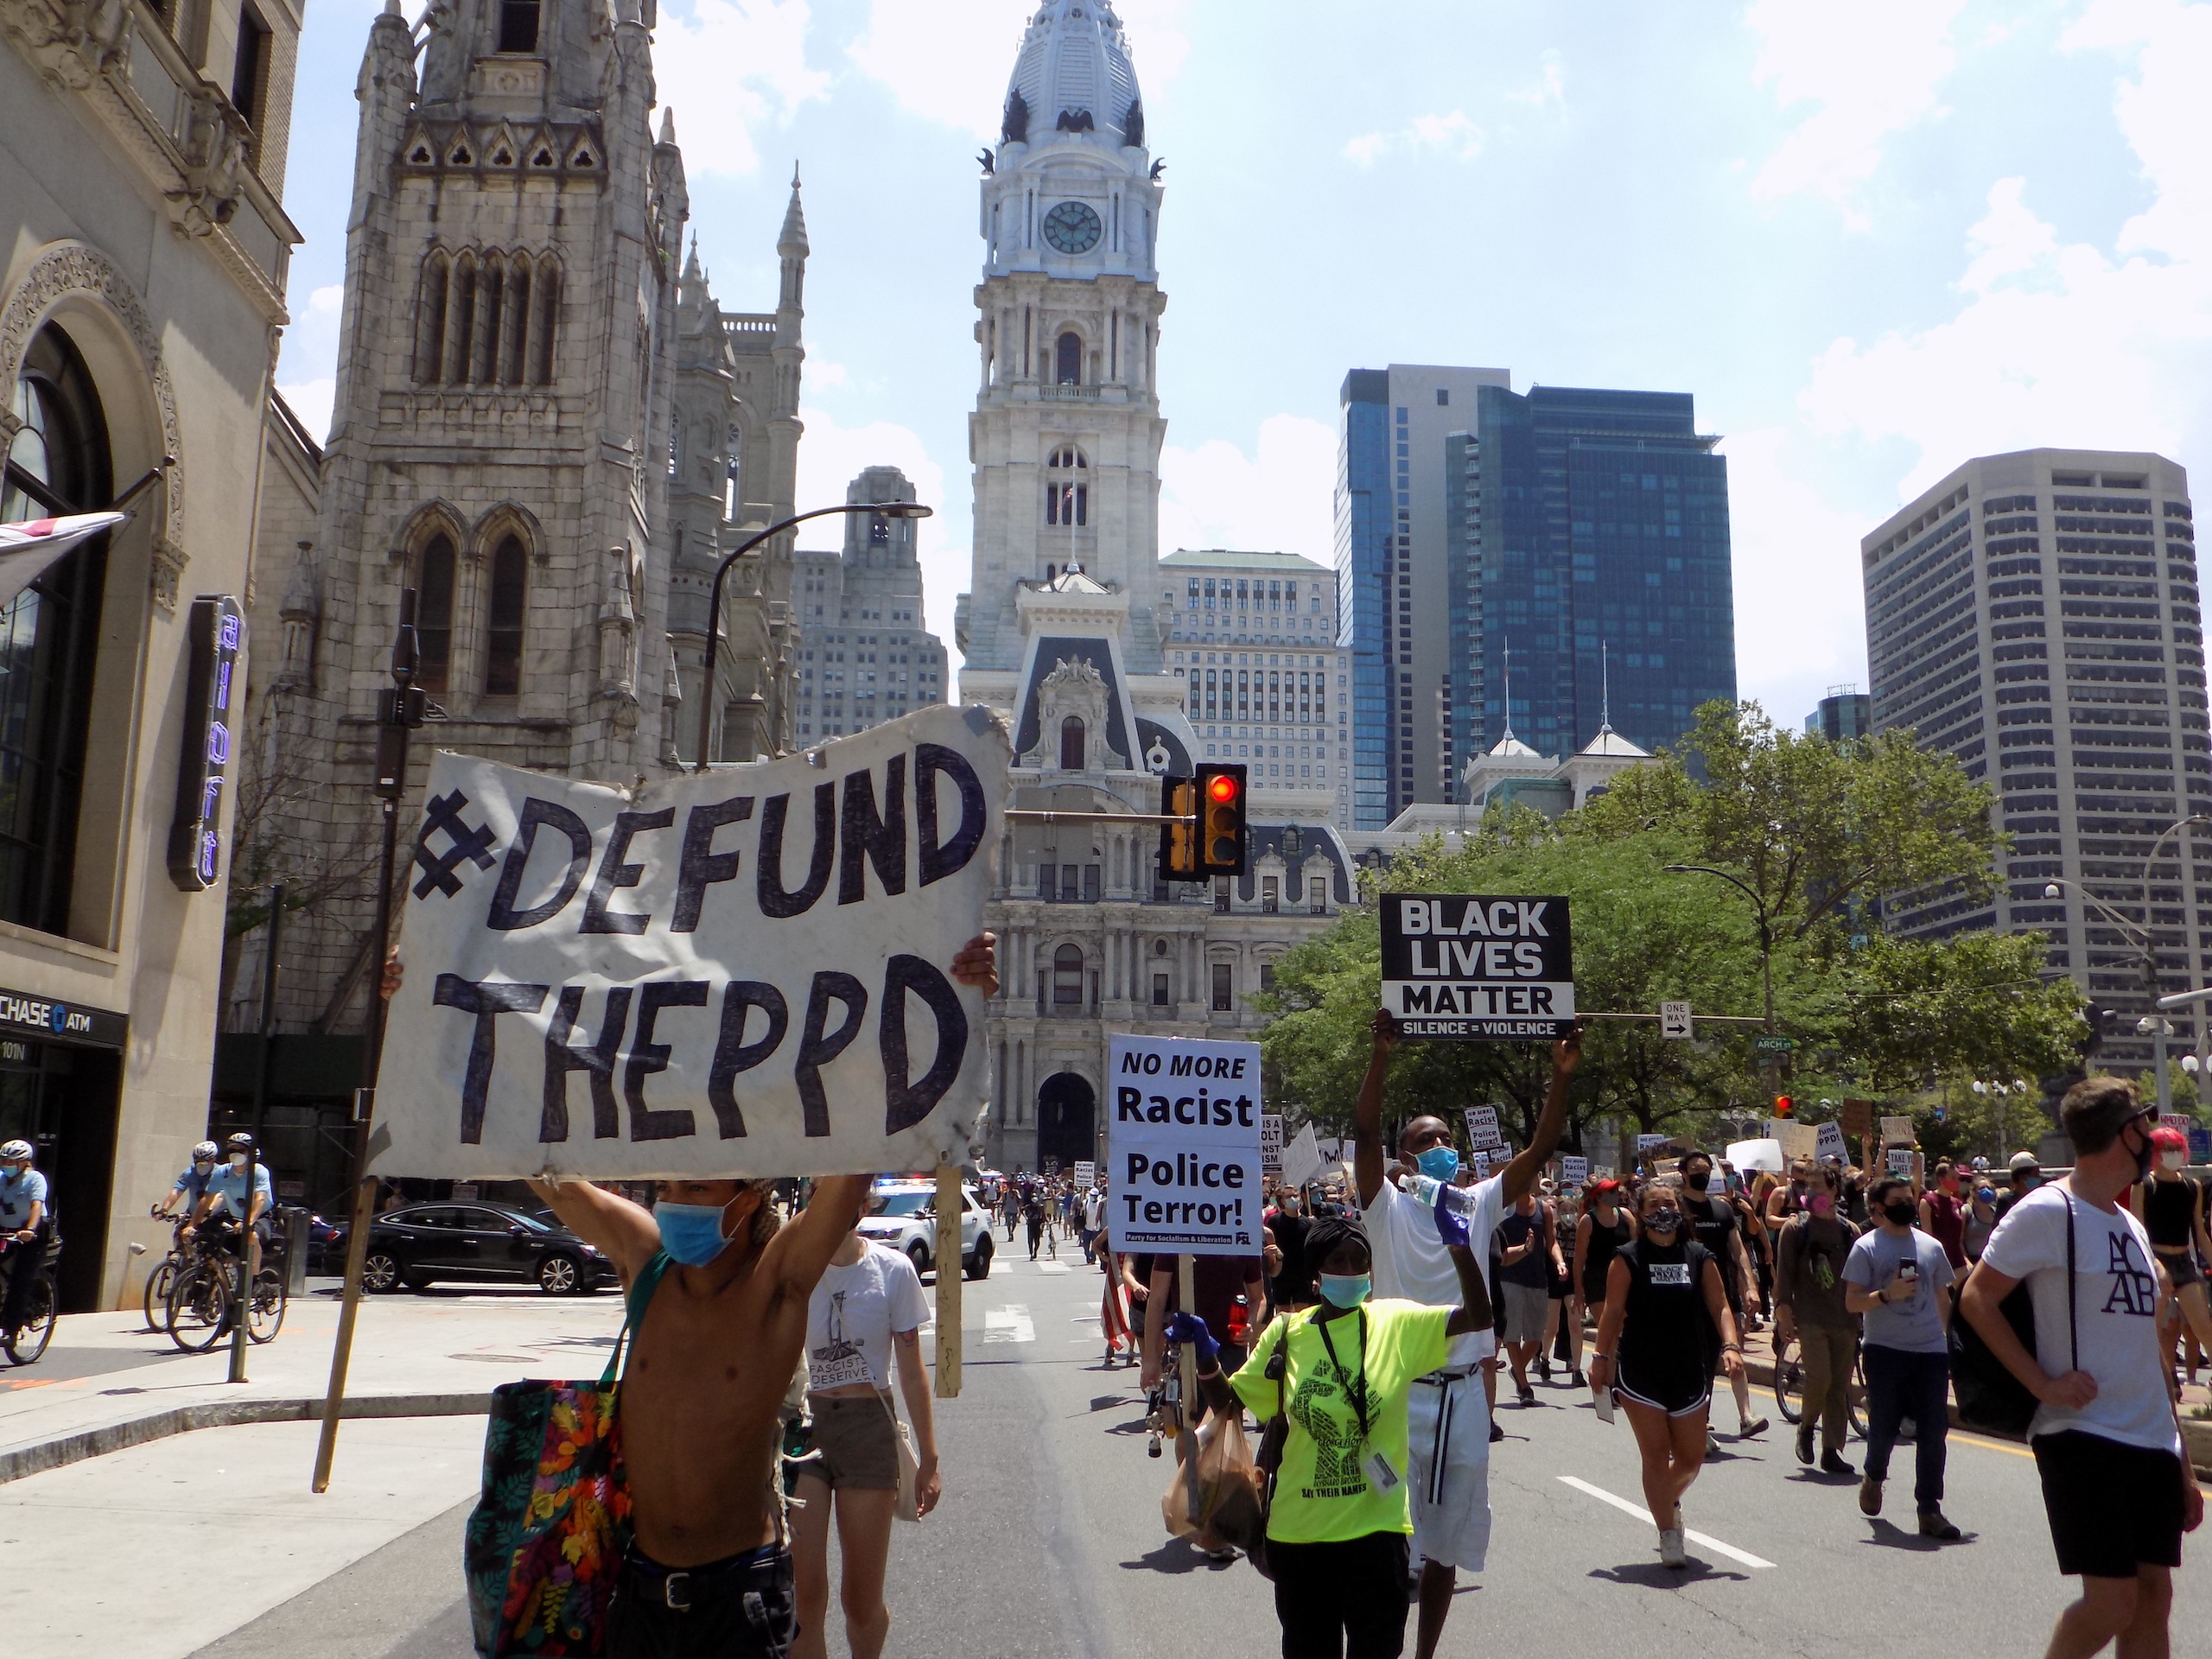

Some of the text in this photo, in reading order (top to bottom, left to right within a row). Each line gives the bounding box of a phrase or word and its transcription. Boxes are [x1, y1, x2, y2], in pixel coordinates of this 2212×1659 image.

[1401, 899, 1549, 937] BLACK
[1411, 940, 1543, 976] LIVES
[1402, 985, 1554, 1014] MATTER
[0, 995, 91, 1033] CHASE ATM
[1402, 1021, 1468, 1034] SILENCE
[1482, 1022, 1556, 1034] VIOLENCE
[2, 1040, 25, 1060] 101N
[1122, 1052, 1246, 1079] NO MORE
[1117, 1086, 1254, 1128] Racist
[1262, 1120, 1280, 1128] IS A
[1469, 1116, 1496, 1126] Racist
[1262, 1130, 1280, 1141] OLT
[1473, 1130, 1497, 1139] Police
[1818, 1125, 1836, 1136] fund
[1262, 1145, 1280, 1154] NST
[1262, 1154, 1278, 1163] ISM
[1891, 1154, 1906, 1163] TAKE
[1128, 1153, 1244, 1189] Police
[1123, 1194, 1243, 1226] Terror!
[1236, 1234, 1251, 1244] PSL
[809, 1357, 867, 1374] FASCIST
[811, 1367, 868, 1384] DESERVE
[1344, 1438, 1362, 1446] FLOY
[1315, 1487, 1339, 1497] THEIR
[1341, 1483, 1367, 1496] NAMES
